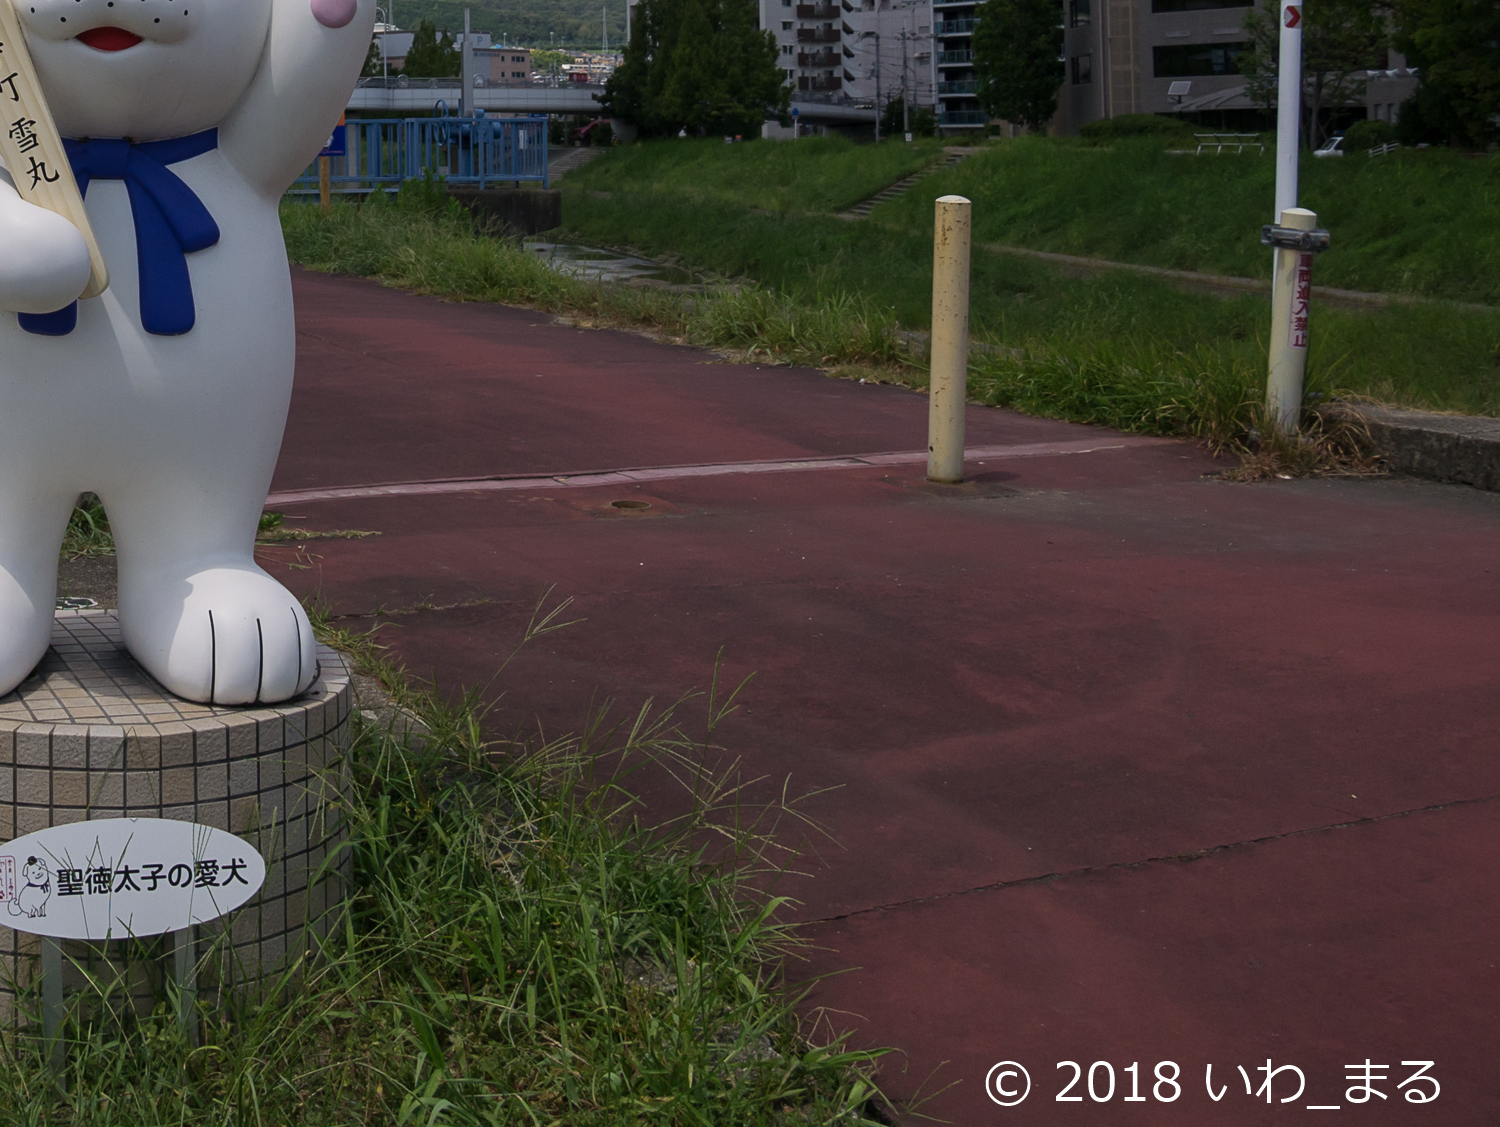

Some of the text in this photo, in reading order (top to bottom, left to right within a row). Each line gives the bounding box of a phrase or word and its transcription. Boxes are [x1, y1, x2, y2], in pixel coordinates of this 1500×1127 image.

[8, 116, 60, 191] 雪丸
[1293, 254, 1313, 347] 車両進入禁止
[56, 857, 249, 897] 聖徳太子の愛犬
